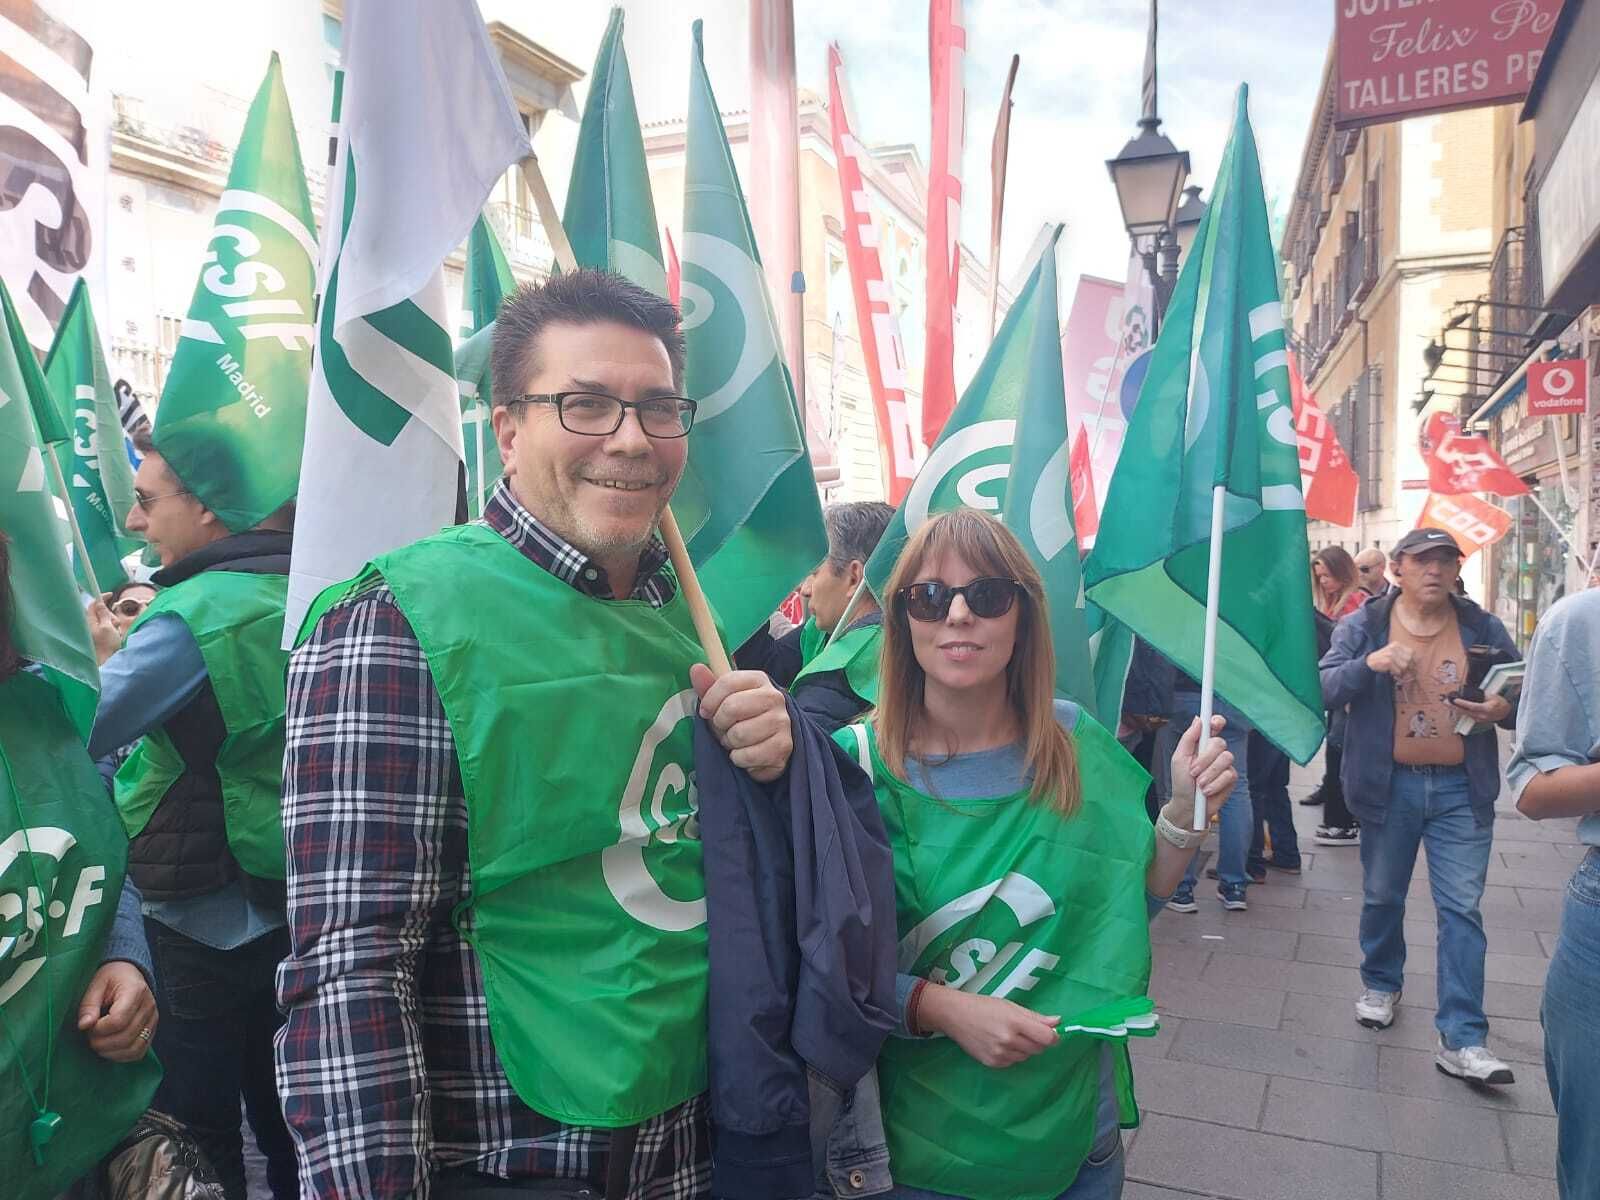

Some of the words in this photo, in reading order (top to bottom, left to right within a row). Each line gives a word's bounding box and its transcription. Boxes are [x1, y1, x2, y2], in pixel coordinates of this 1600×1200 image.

[1369, 17, 1479, 63] Felix
[1491, 0, 1557, 41] Pe
[1344, 58, 1489, 110] TALLERES
[215, 352, 272, 419] Madrid
[1533, 397, 1584, 408] vodafone
